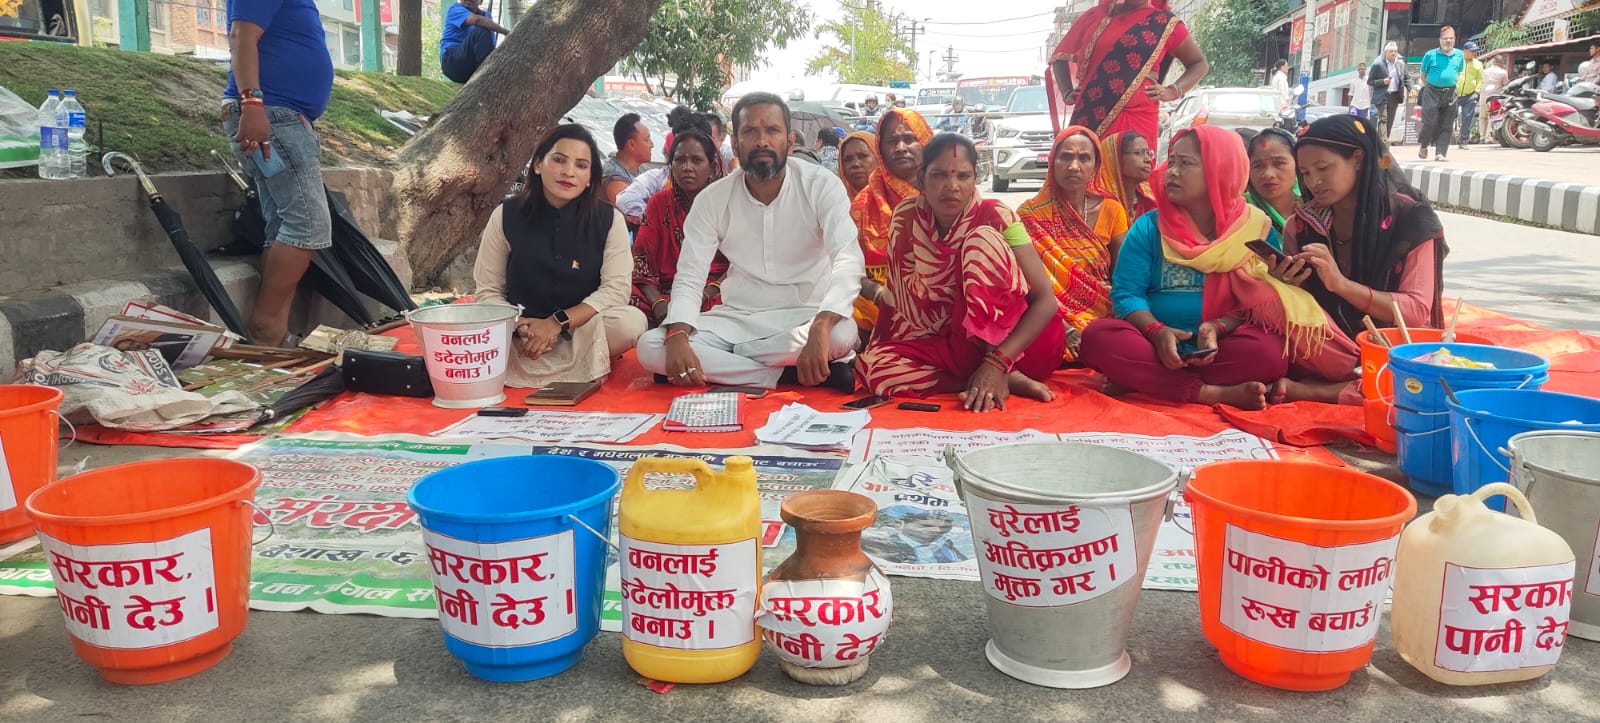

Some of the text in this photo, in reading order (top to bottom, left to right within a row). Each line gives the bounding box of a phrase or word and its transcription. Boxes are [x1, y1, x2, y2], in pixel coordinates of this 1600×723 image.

[440, 328, 491, 345] वनलाई
[433, 347, 500, 365] डढेलोमुक्त
[445, 366, 481, 379] बनाउ
[986, 503, 1081, 537] चुरेलाई
[426, 543, 555, 585] सरकार,
[628, 546, 719, 578] वनलाई
[982, 533, 1119, 572] आतिक्रमण
[992, 571, 1042, 601] मुक्त
[1050, 570, 1097, 595] गर
[1227, 548, 1331, 591] पानीको
[1338, 557, 1393, 591] लागि
[124, 595, 186, 631] देउ
[490, 593, 548, 629] देउ
[631, 612, 695, 640] बनाउ
[1241, 596, 1300, 629] रूख
[835, 632, 882, 661] देउ
[1444, 618, 1526, 655] पानी
